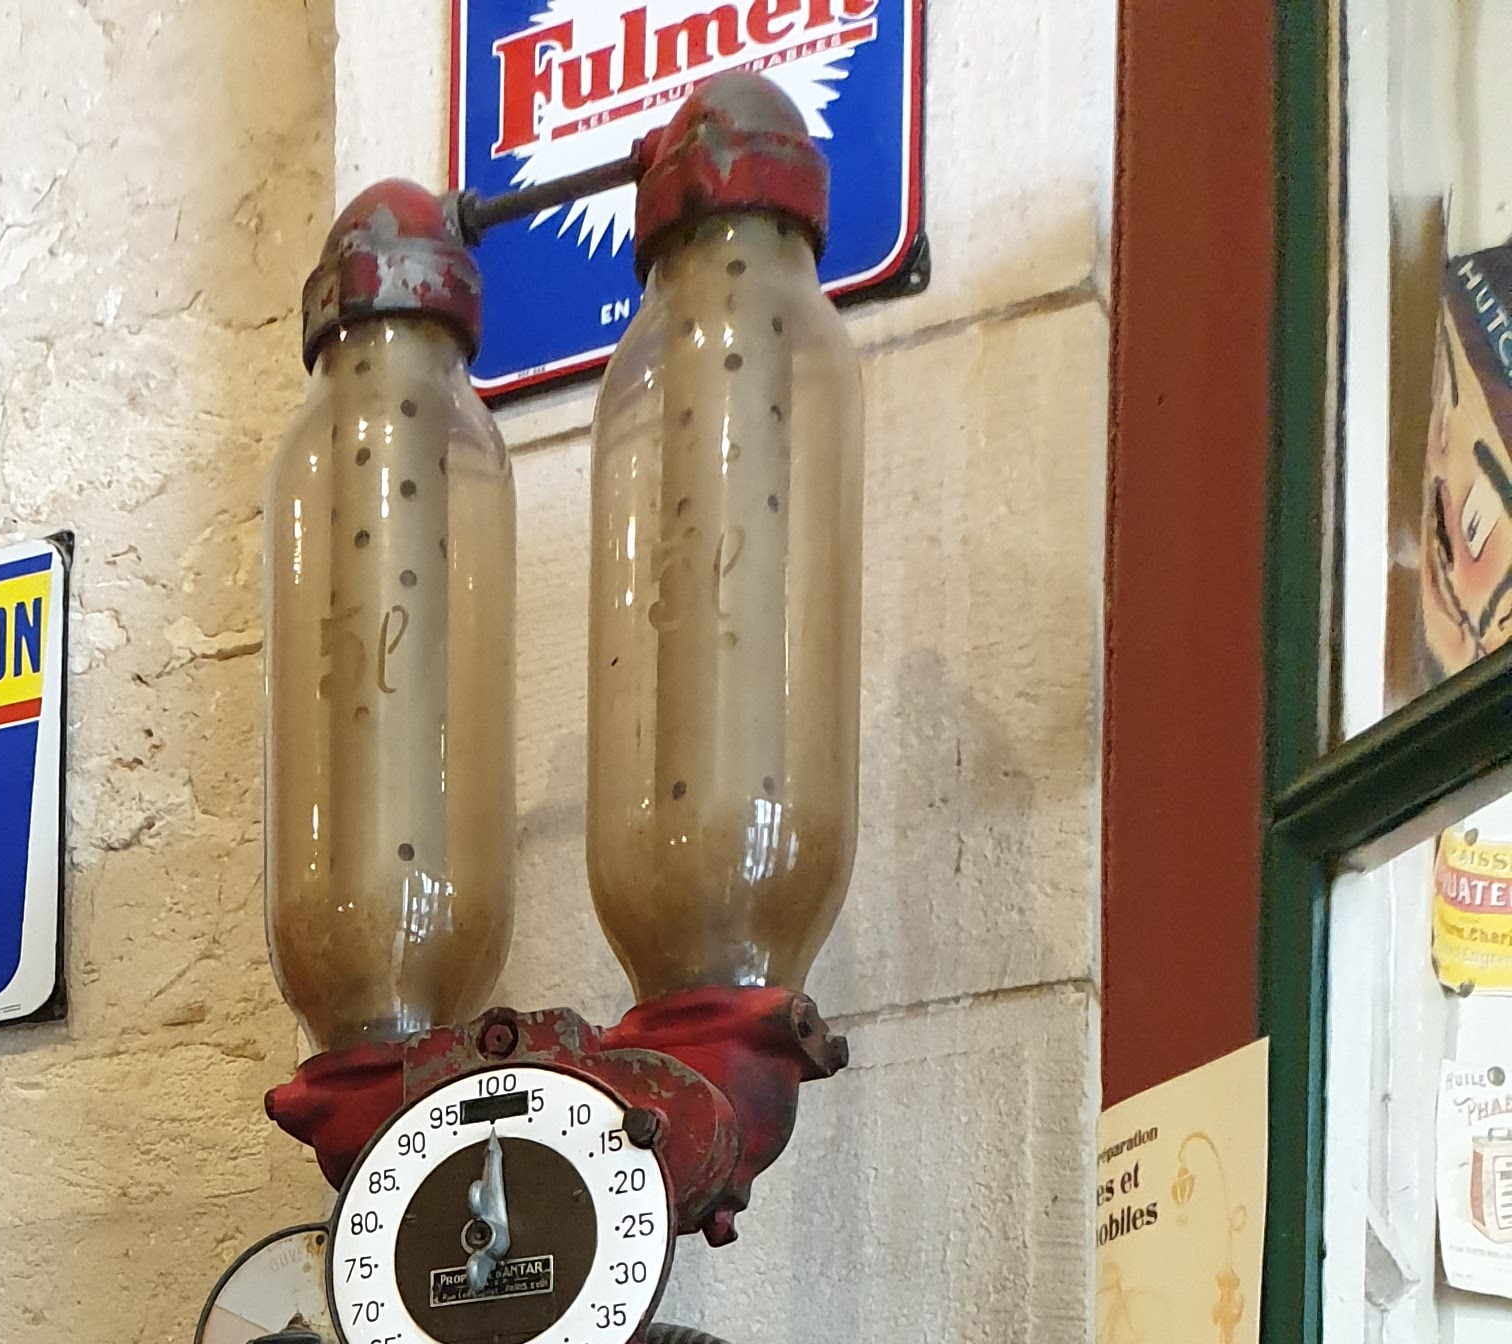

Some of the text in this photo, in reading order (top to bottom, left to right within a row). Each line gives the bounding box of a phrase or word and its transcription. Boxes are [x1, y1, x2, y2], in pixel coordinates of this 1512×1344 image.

[600, 299, 631, 325] EN
[477, 1072, 518, 1097] 100
[530, 1088, 546, 1113] 5
[429, 1104, 459, 1130] 95
[568, 1103, 592, 1128] 10
[397, 1131, 427, 1156] 90
[599, 1128, 624, 1155] 15
[368, 1168, 397, 1194] 85
[614, 1167, 647, 1196] 20
[1120, 1161, 1140, 1195] et
[350, 1210, 379, 1236] 80
[621, 1212, 655, 1240] 25
[1096, 1201, 1159, 1248] obiles
[344, 1256, 374, 1284] 75
[614, 1260, 648, 1286] 30
[351, 1300, 381, 1327] 70
[595, 1302, 628, 1329] 35
